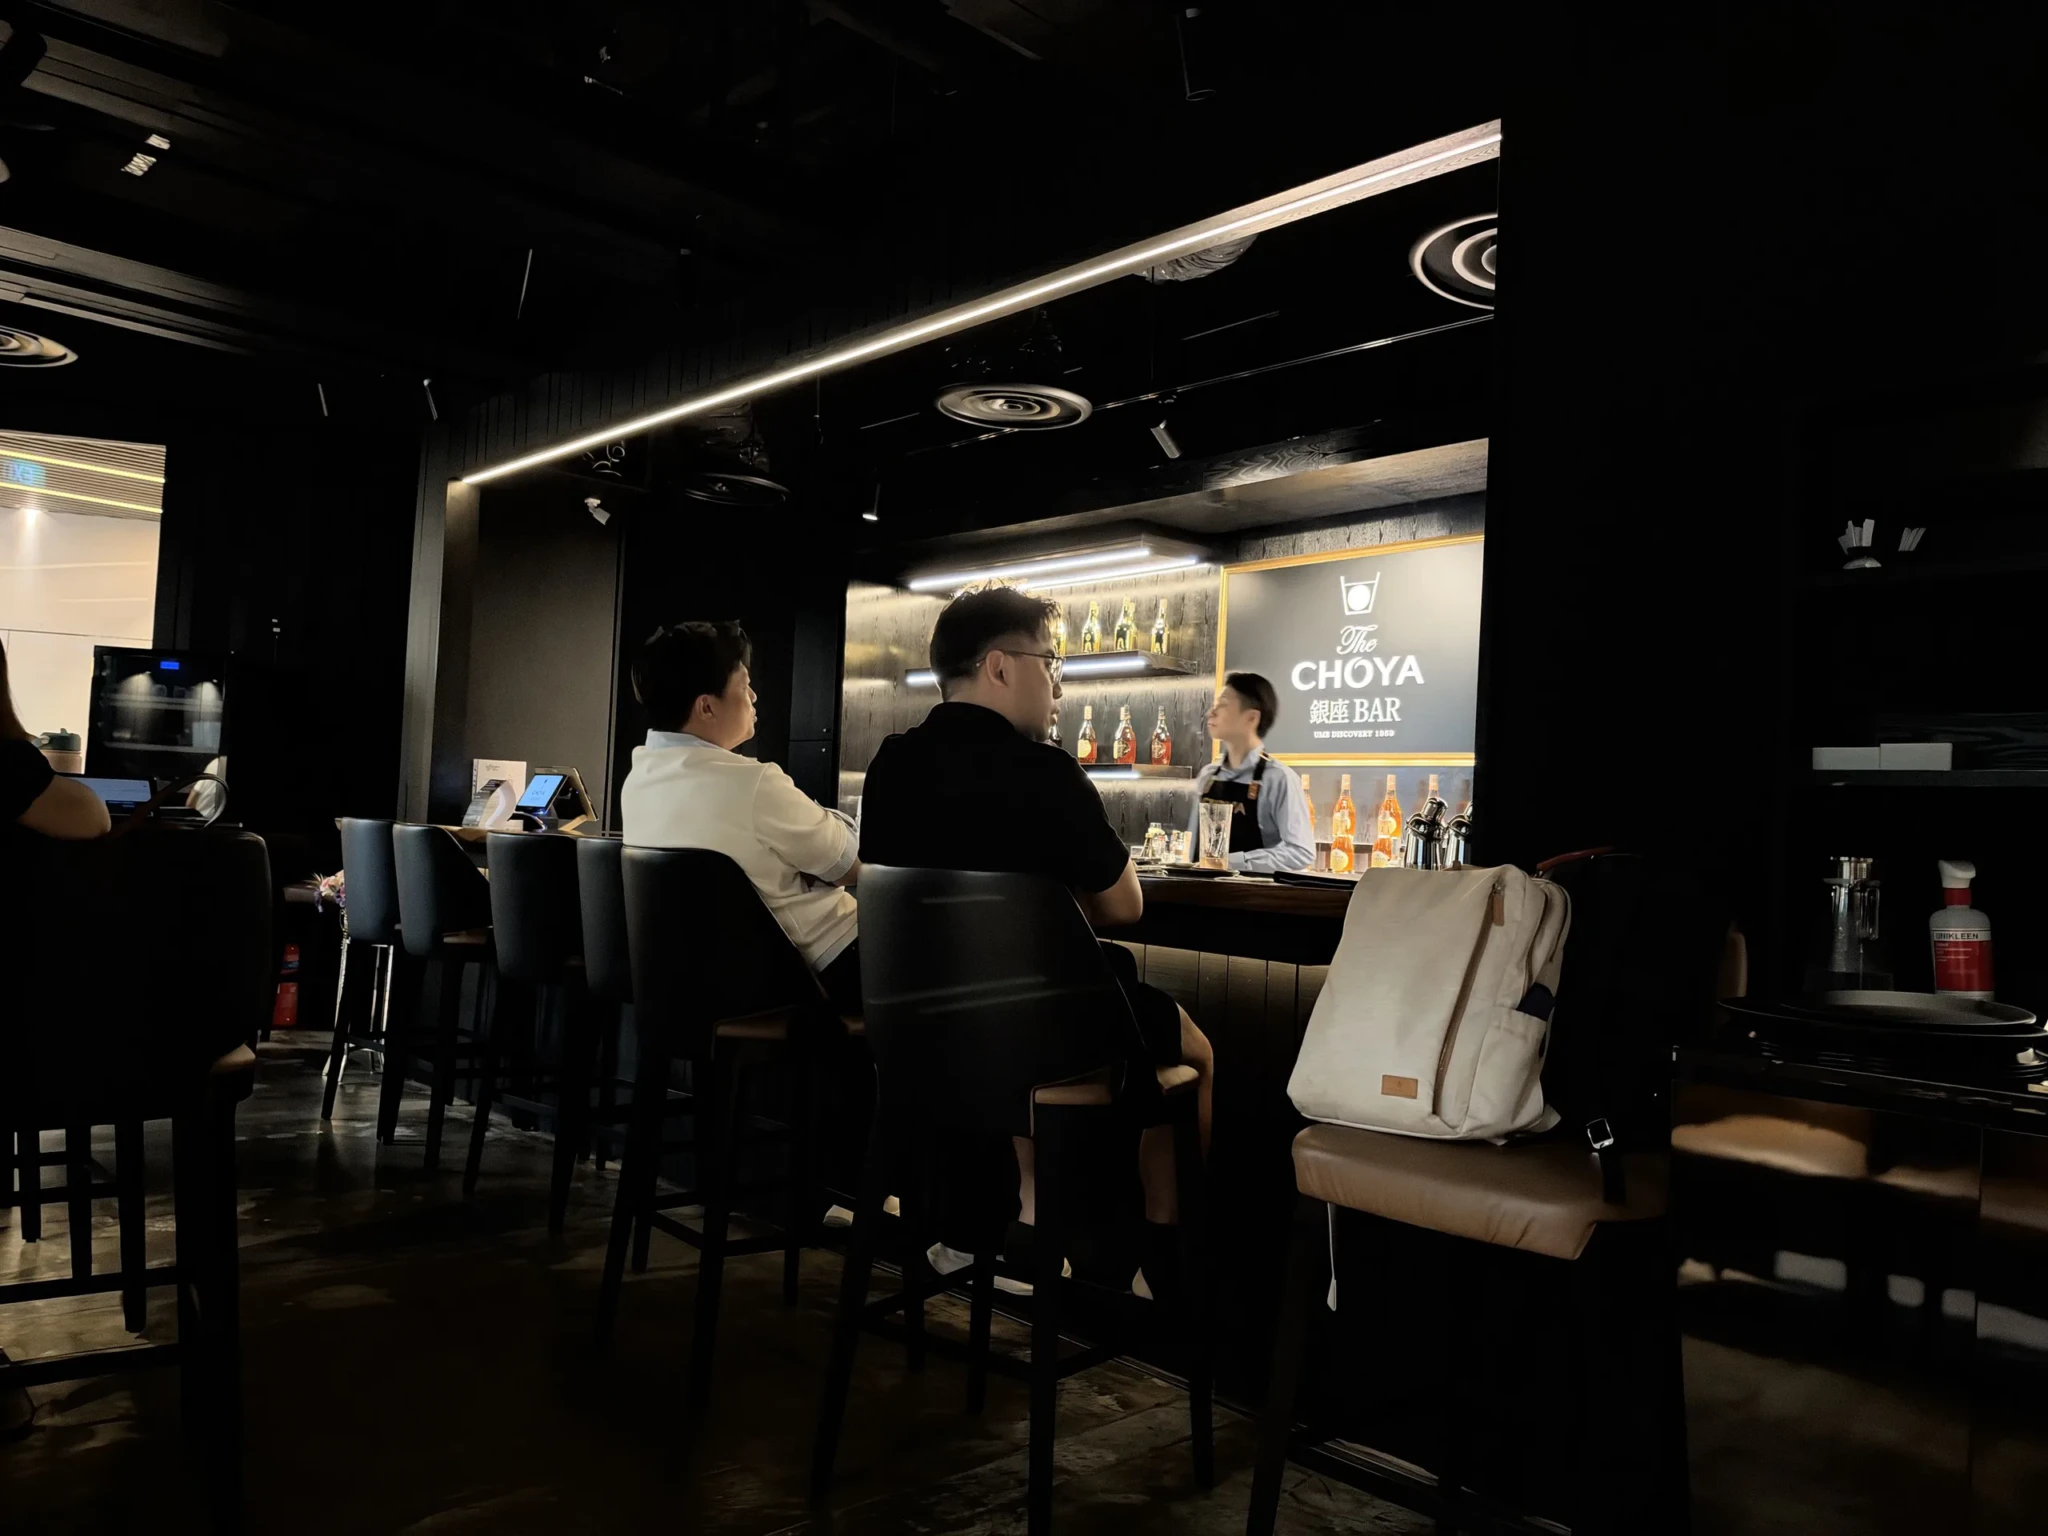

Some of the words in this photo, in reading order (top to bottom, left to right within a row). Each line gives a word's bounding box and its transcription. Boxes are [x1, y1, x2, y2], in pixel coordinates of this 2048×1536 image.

[1336, 624, 1379, 655] The
[1291, 654, 1425, 691] CHOYA
[1309, 698, 1350, 724] 銀座
[1353, 697, 1402, 723] BAR
[1331, 730, 1374, 738] DISCOVERY
